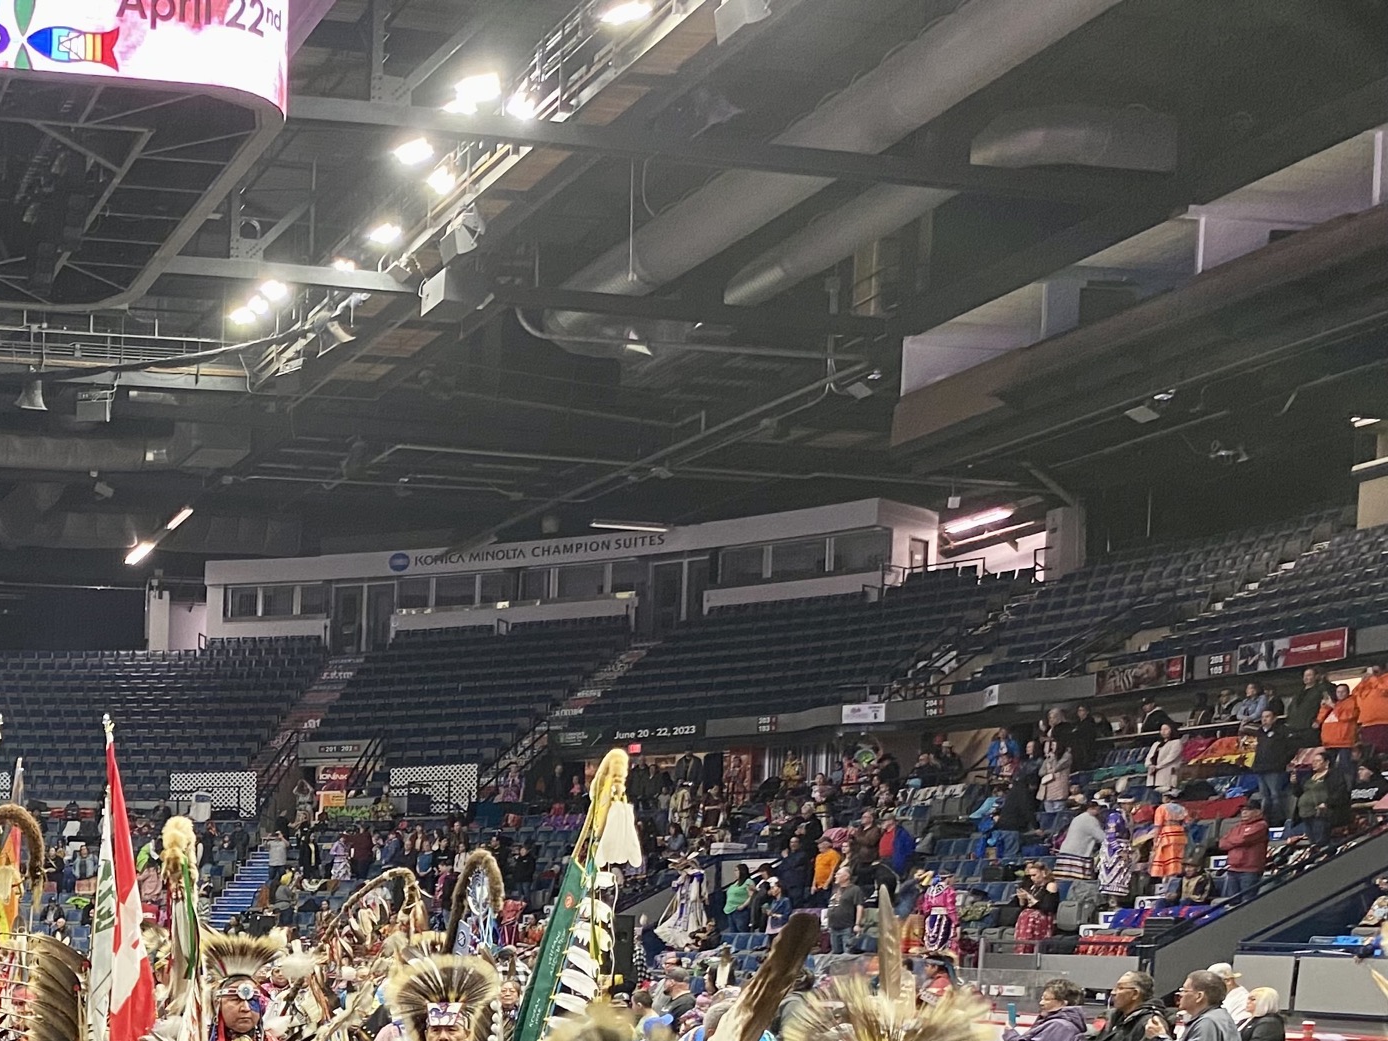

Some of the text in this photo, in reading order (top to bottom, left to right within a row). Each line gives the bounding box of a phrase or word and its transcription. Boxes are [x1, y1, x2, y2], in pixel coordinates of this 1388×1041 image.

[116, 0, 282, 38] April 22nd
[414, 533, 666, 567] KONICA MINOLTA CHAMPION SUITES
[614, 731, 636, 740] June
[637, 729, 649, 738] 20
[656, 727, 671, 737] 22,
[672, 725, 696, 735] 2023
